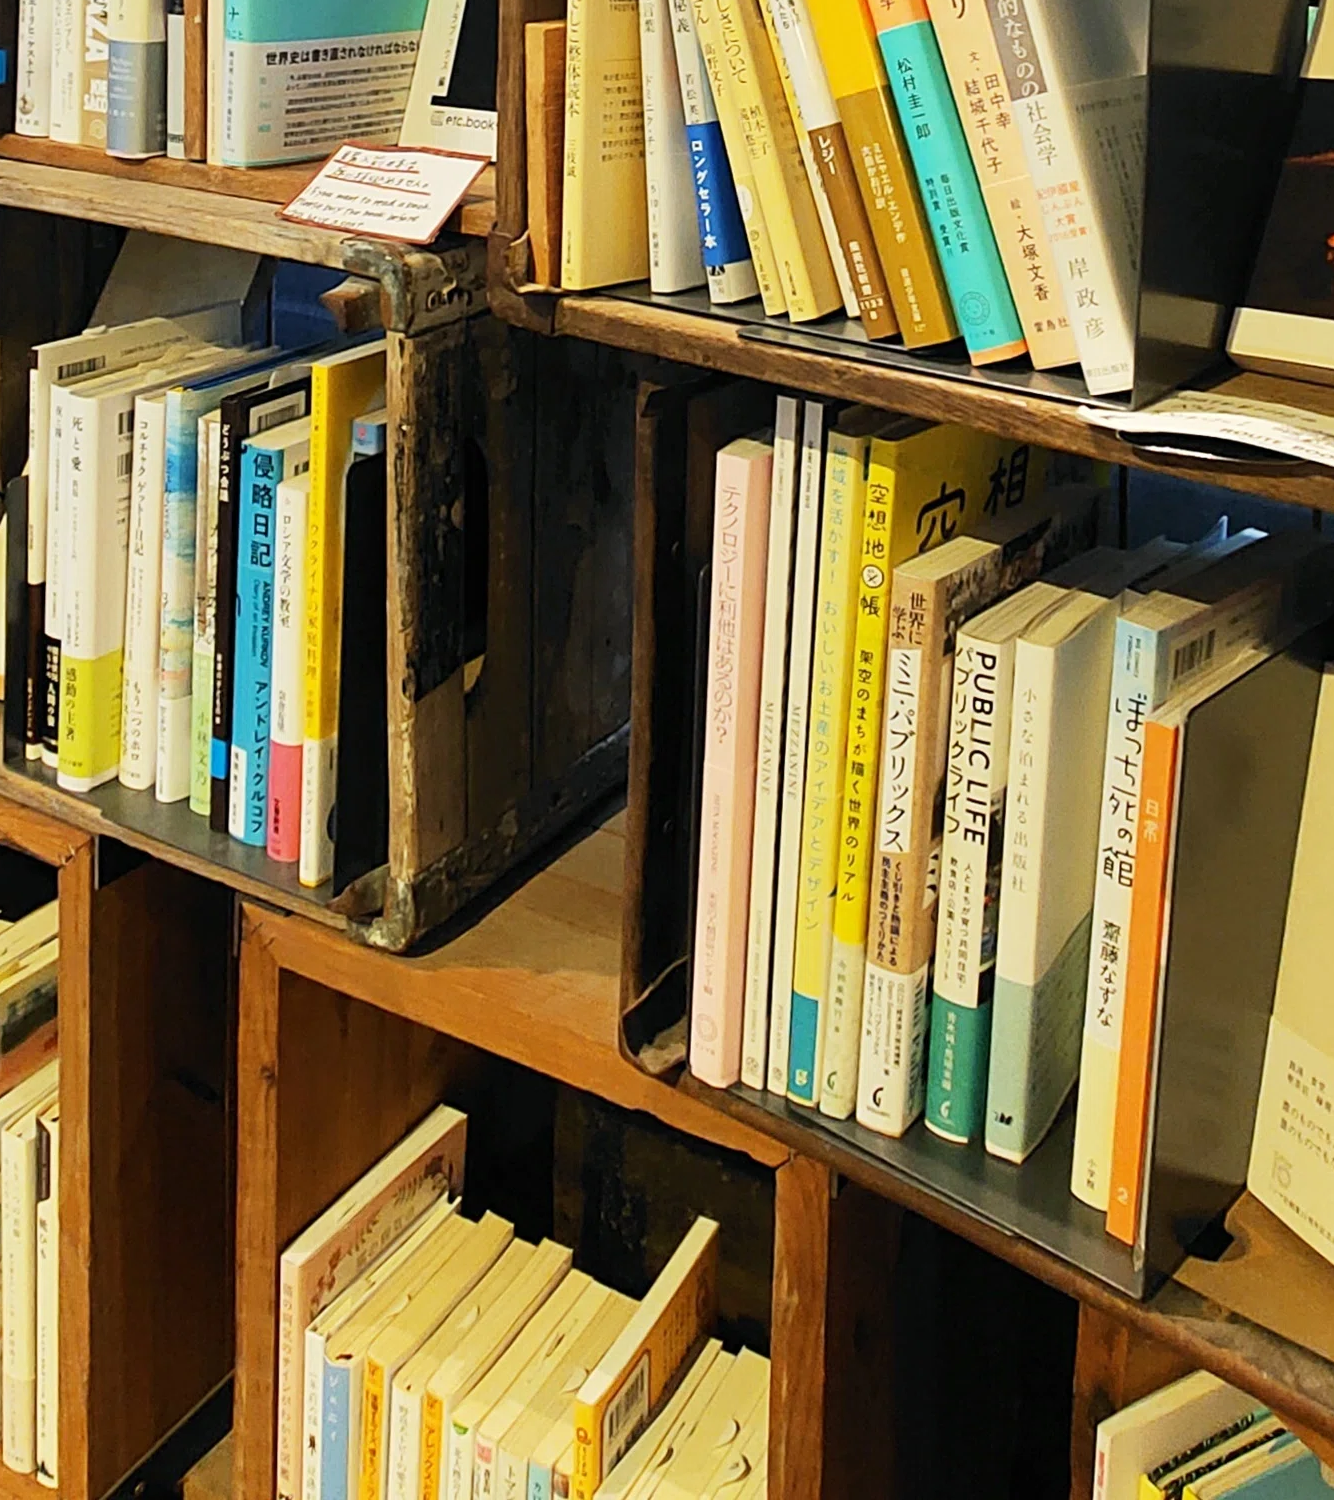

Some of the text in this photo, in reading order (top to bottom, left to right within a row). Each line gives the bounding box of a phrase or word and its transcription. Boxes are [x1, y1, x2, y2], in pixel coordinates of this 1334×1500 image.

[685, 73, 701, 124] 若松英
[704, 42, 723, 98] 高野文子
[897, 58, 932, 141] 松村圭一郎
[983, 72, 1013, 130] 田中幸
[445, 112, 497, 131] etc.book
[749, 105, 773, 157] 植本一子
[817, 134, 836, 176] レジー
[1026, 101, 1060, 168] 社会学
[691, 139, 718, 250] ロングセラー本
[940, 173, 971, 254] 毎日出版文化賞
[1010, 198, 1051, 303] 絵・大塚文香
[1067, 257, 1107, 341] 岸政彦
[70, 416, 85, 473] 死と愛
[134, 420, 149, 557] コルチャク ゲットー日記
[219, 423, 231, 503] どうぶつ会議
[250, 453, 275, 568] 侵略日記
[279, 514, 292, 629] ロシア文学の教室
[712, 485, 742, 745] テクノロジーに利他はあるのか?
[908, 591, 928, 645] 世界に
[892, 605, 908, 644] 学ぶ
[250, 680, 268, 834] アンドレイ・クルコフ
[760, 700, 775, 796] MEZZANINE
[786, 702, 802, 800] MEZZANINE
[840, 649, 874, 903] 架空のまちが描く世界のリアル
[946, 647, 976, 833] パブリックライフ
[962, 651, 997, 846] PUBLIC LIFE
[1011, 687, 1038, 894] 小さな泊まれる出版社
[1101, 692, 1147, 889] ぼっち死の館
[1144, 798, 1161, 844] 日常
[874, 855, 891, 963] 民主主義のつくりかた
[1096, 918, 1123, 1029] 齋藤なずな
